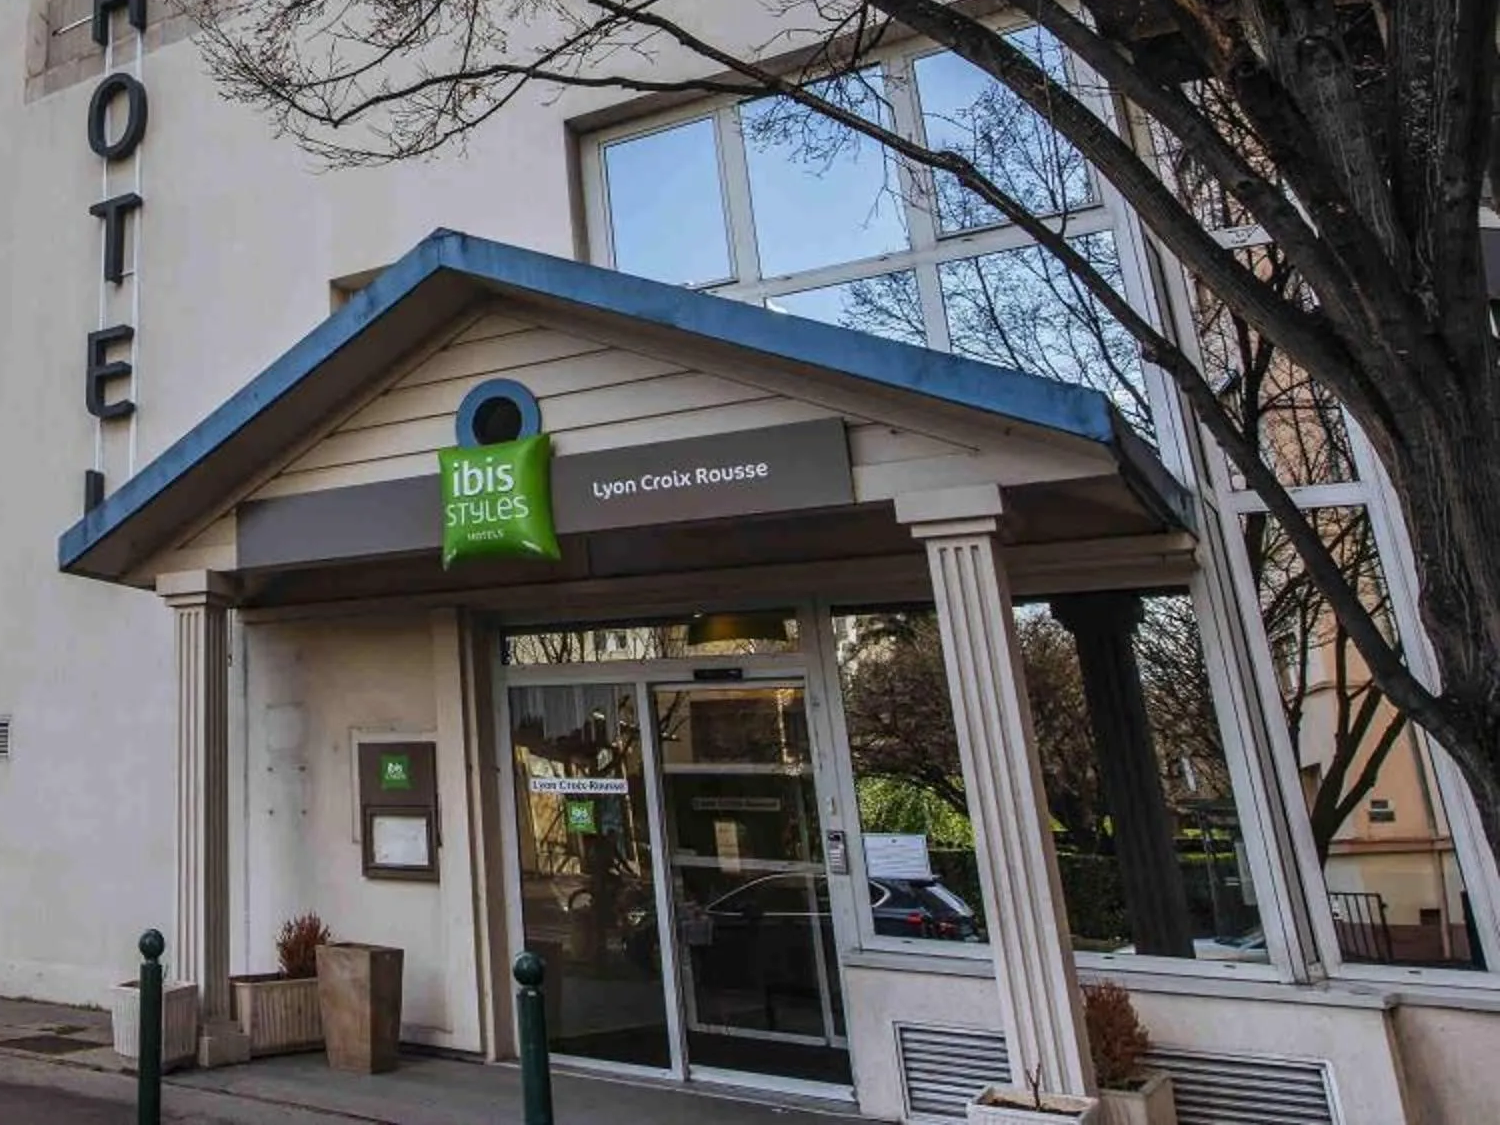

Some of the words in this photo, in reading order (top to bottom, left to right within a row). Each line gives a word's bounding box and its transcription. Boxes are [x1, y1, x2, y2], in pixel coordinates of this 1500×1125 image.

[453, 456, 515, 497] ibis
[593, 479, 637, 500] Lyon
[640, 470, 692, 491] Croix
[695, 462, 769, 485] Rousse
